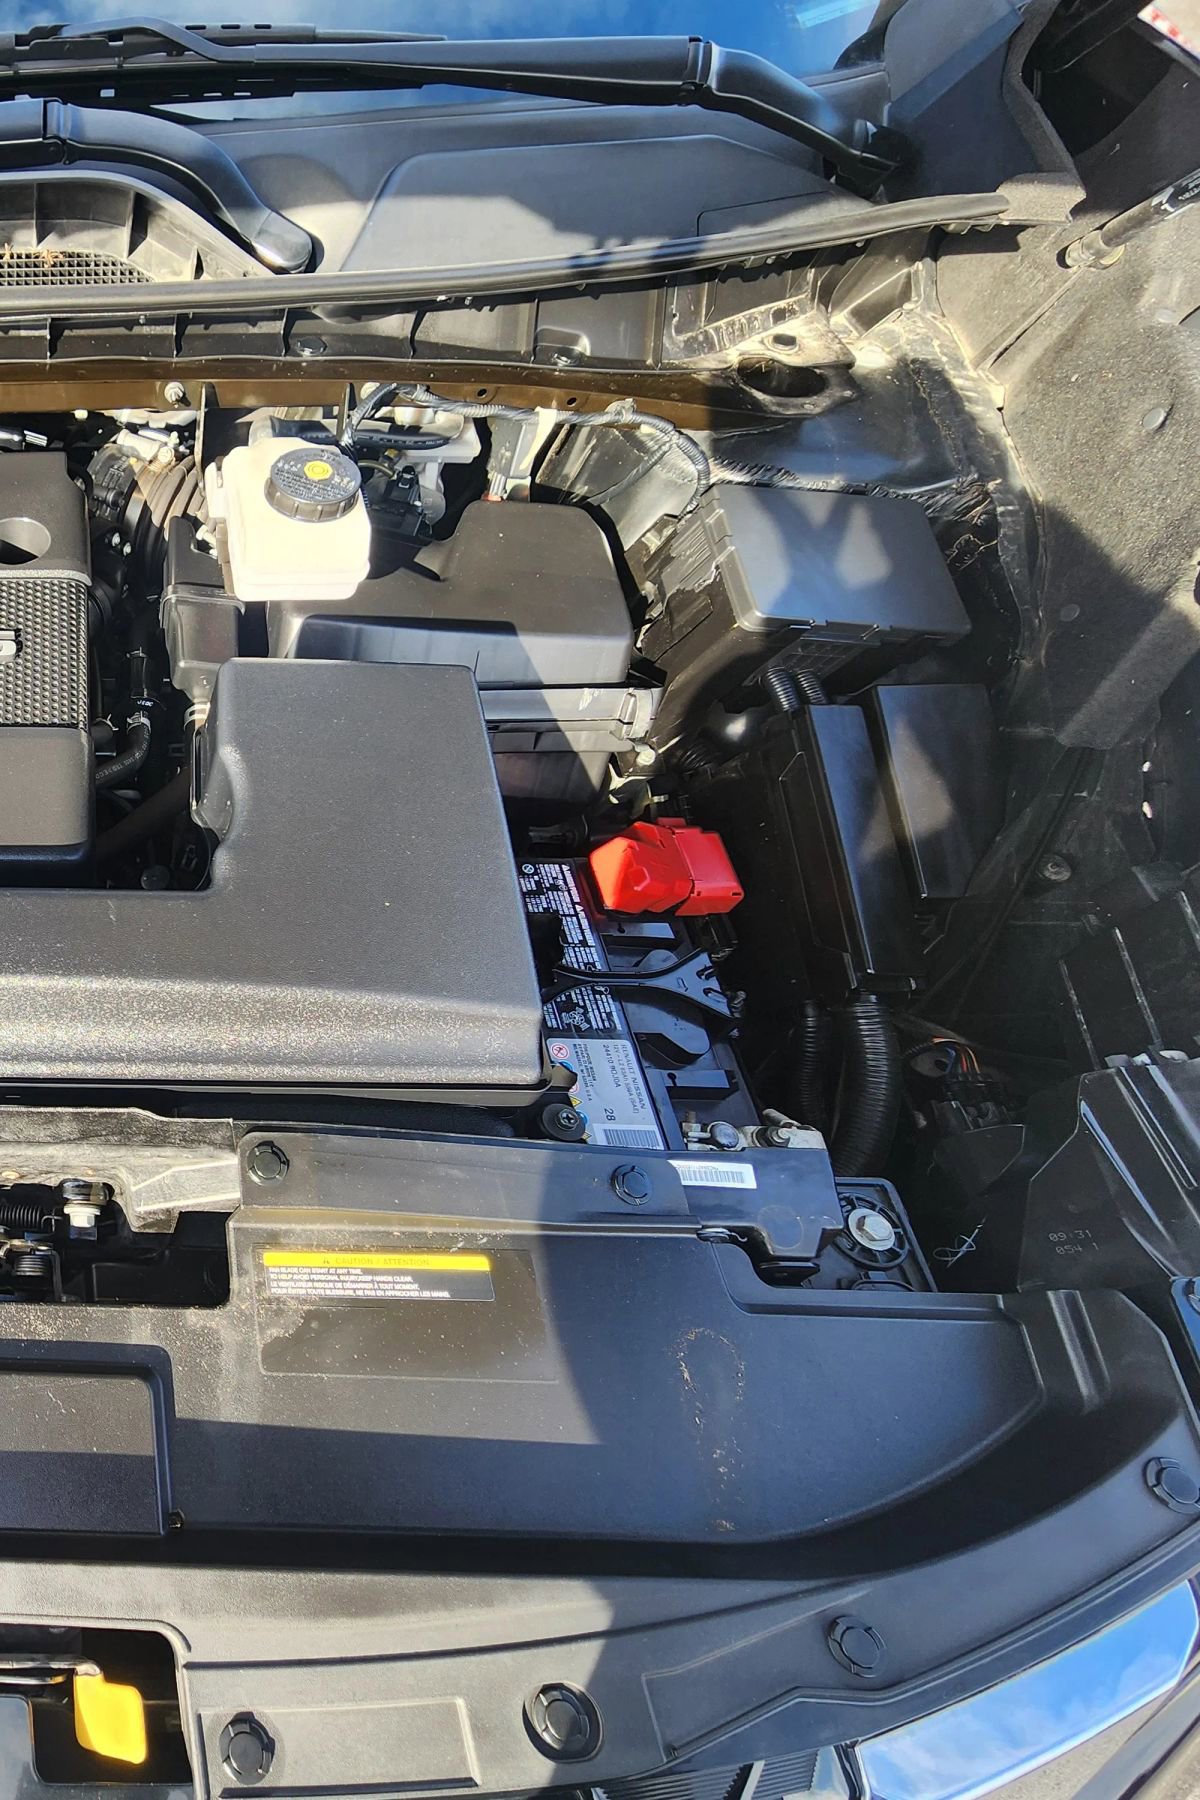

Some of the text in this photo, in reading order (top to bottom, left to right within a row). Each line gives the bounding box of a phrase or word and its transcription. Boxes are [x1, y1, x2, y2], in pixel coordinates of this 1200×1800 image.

[602, 1044, 613, 1063] 24410
[620, 1044, 646, 1109] RENAULT NISSAN
[603, 1108, 616, 1120] 28
[335, 1257, 374, 1265] CAUTION
[383, 1258, 430, 1266] ATTENTION
